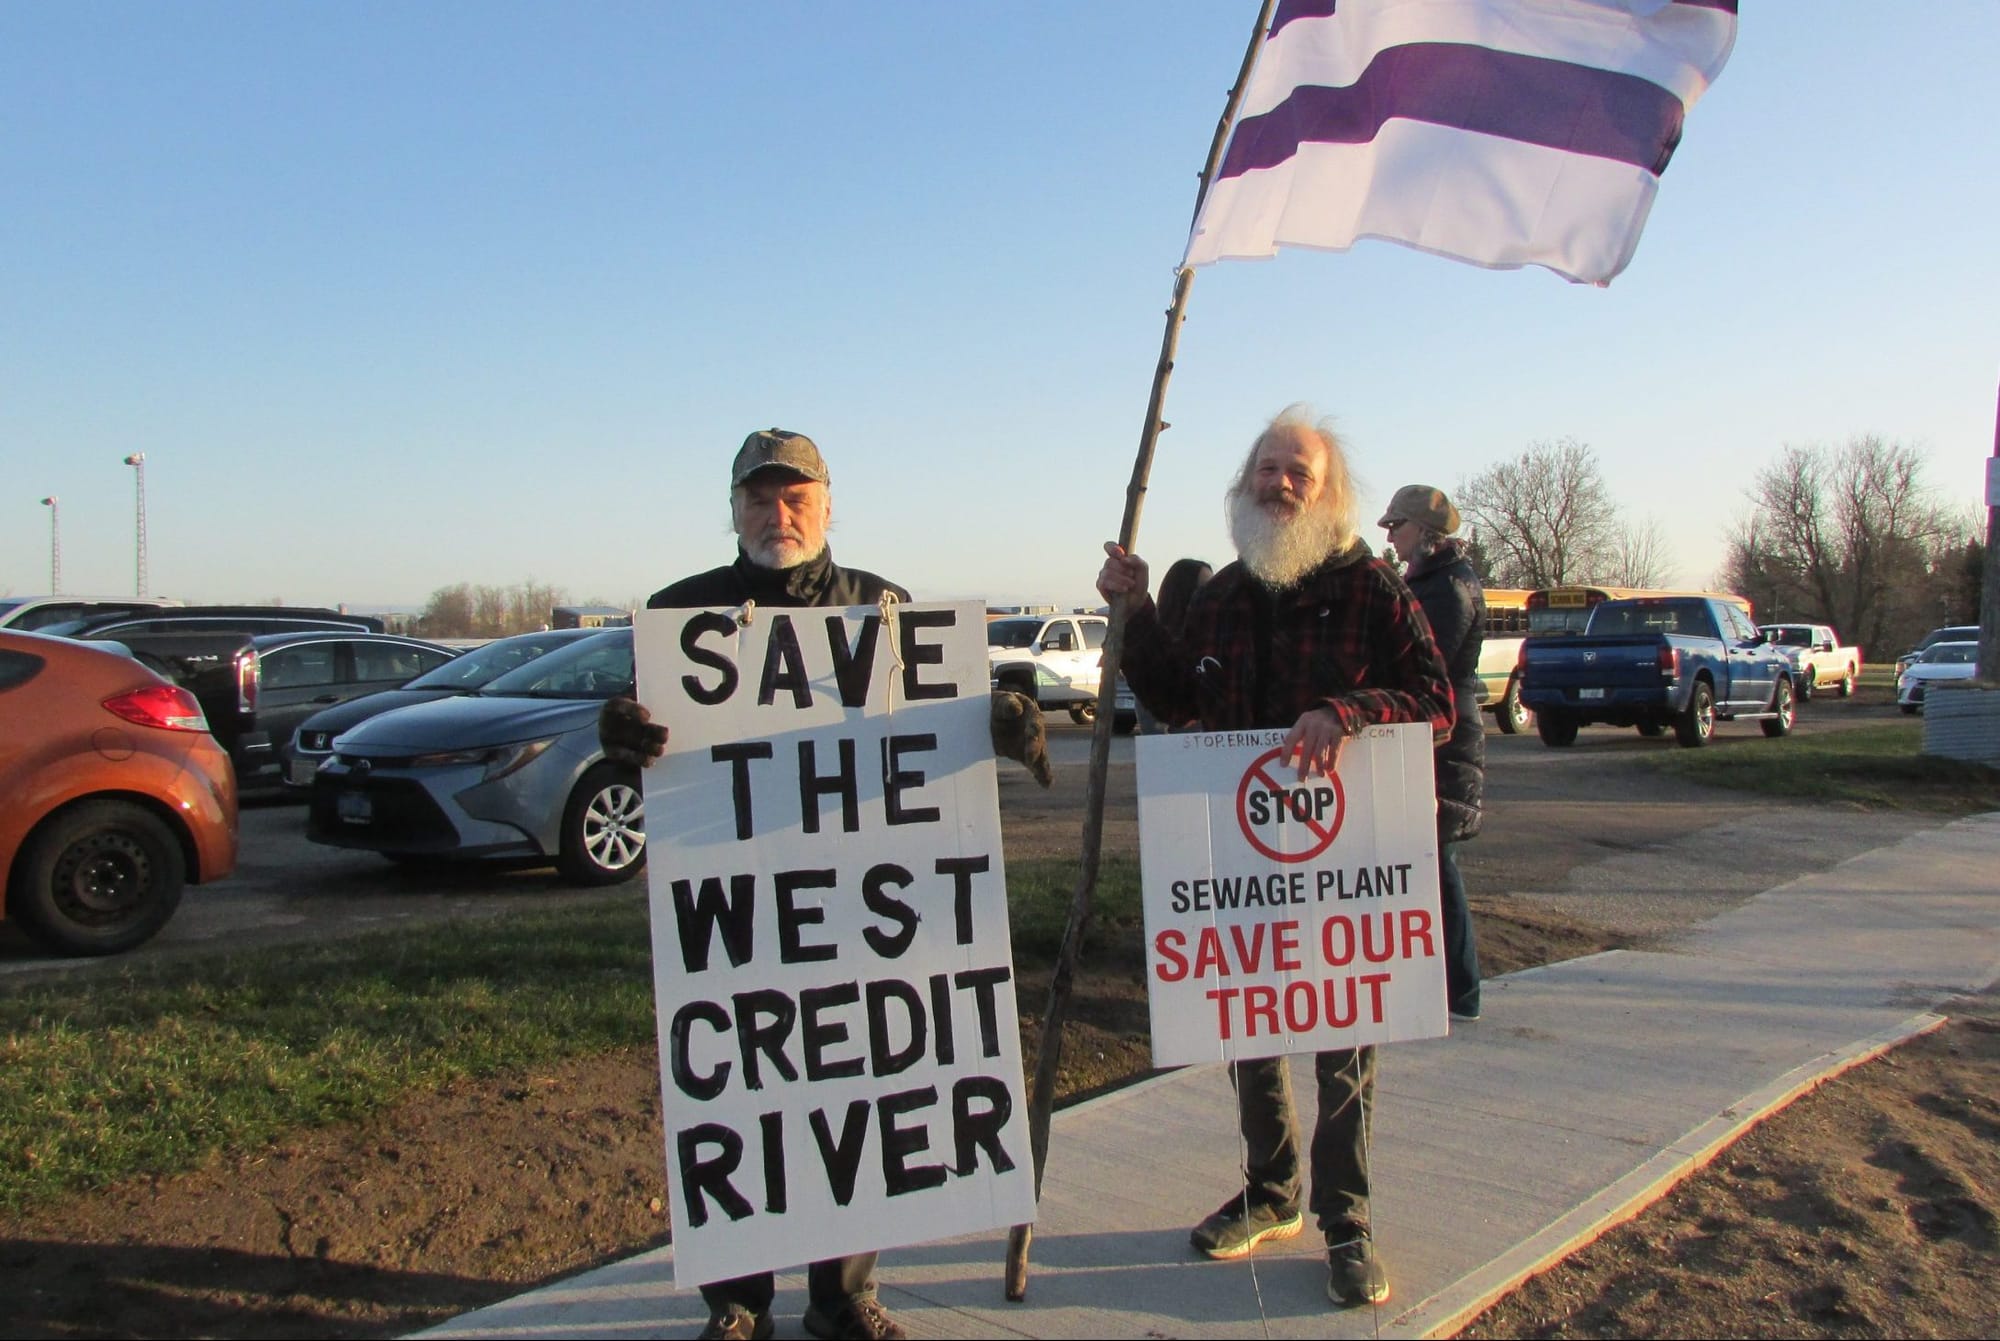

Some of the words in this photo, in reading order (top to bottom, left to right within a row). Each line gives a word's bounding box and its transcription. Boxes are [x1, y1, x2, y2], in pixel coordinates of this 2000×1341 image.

[680, 610, 958, 708] SAVE
[711, 733, 940, 840] THE
[1249, 787, 1334, 825] STOP
[670, 854, 989, 973] WEST
[1171, 872, 1306, 914] SEWAGE
[1317, 864, 1412, 901] PLANT
[1155, 920, 1301, 982] SAVE
[1321, 909, 1435, 966] OUR
[670, 966, 1011, 1101] CREDIT
[1206, 973, 1391, 1041] TROUT
[677, 1076, 1016, 1228] RIVER
